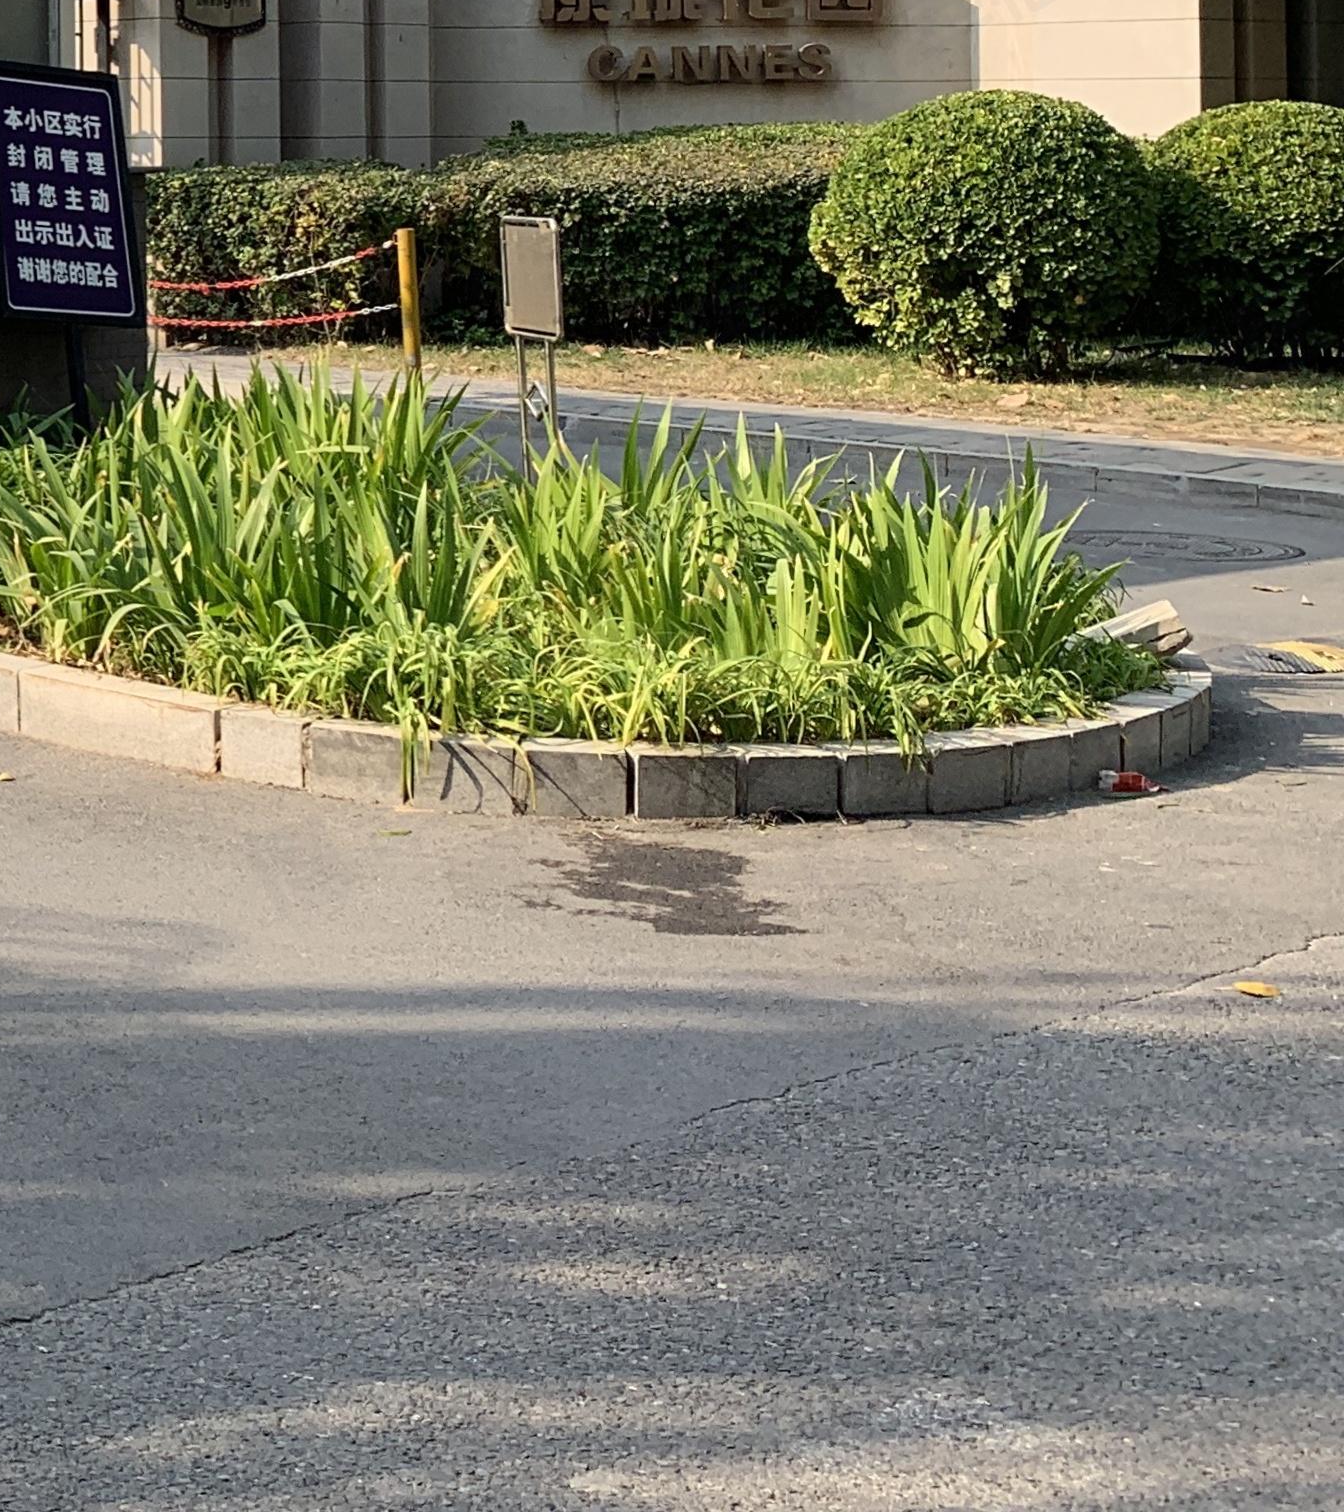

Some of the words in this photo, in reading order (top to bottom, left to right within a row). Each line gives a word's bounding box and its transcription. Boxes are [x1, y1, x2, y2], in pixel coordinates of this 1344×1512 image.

[586, 43, 833, 83] CANNES
[3, 106, 102, 139] 本小区实行
[6, 143, 107, 176] 封闭管理
[10, 181, 110, 213] 请您主动
[15, 219, 115, 250] 出示出入证
[17, 257, 119, 288] 谢谢您的配合
